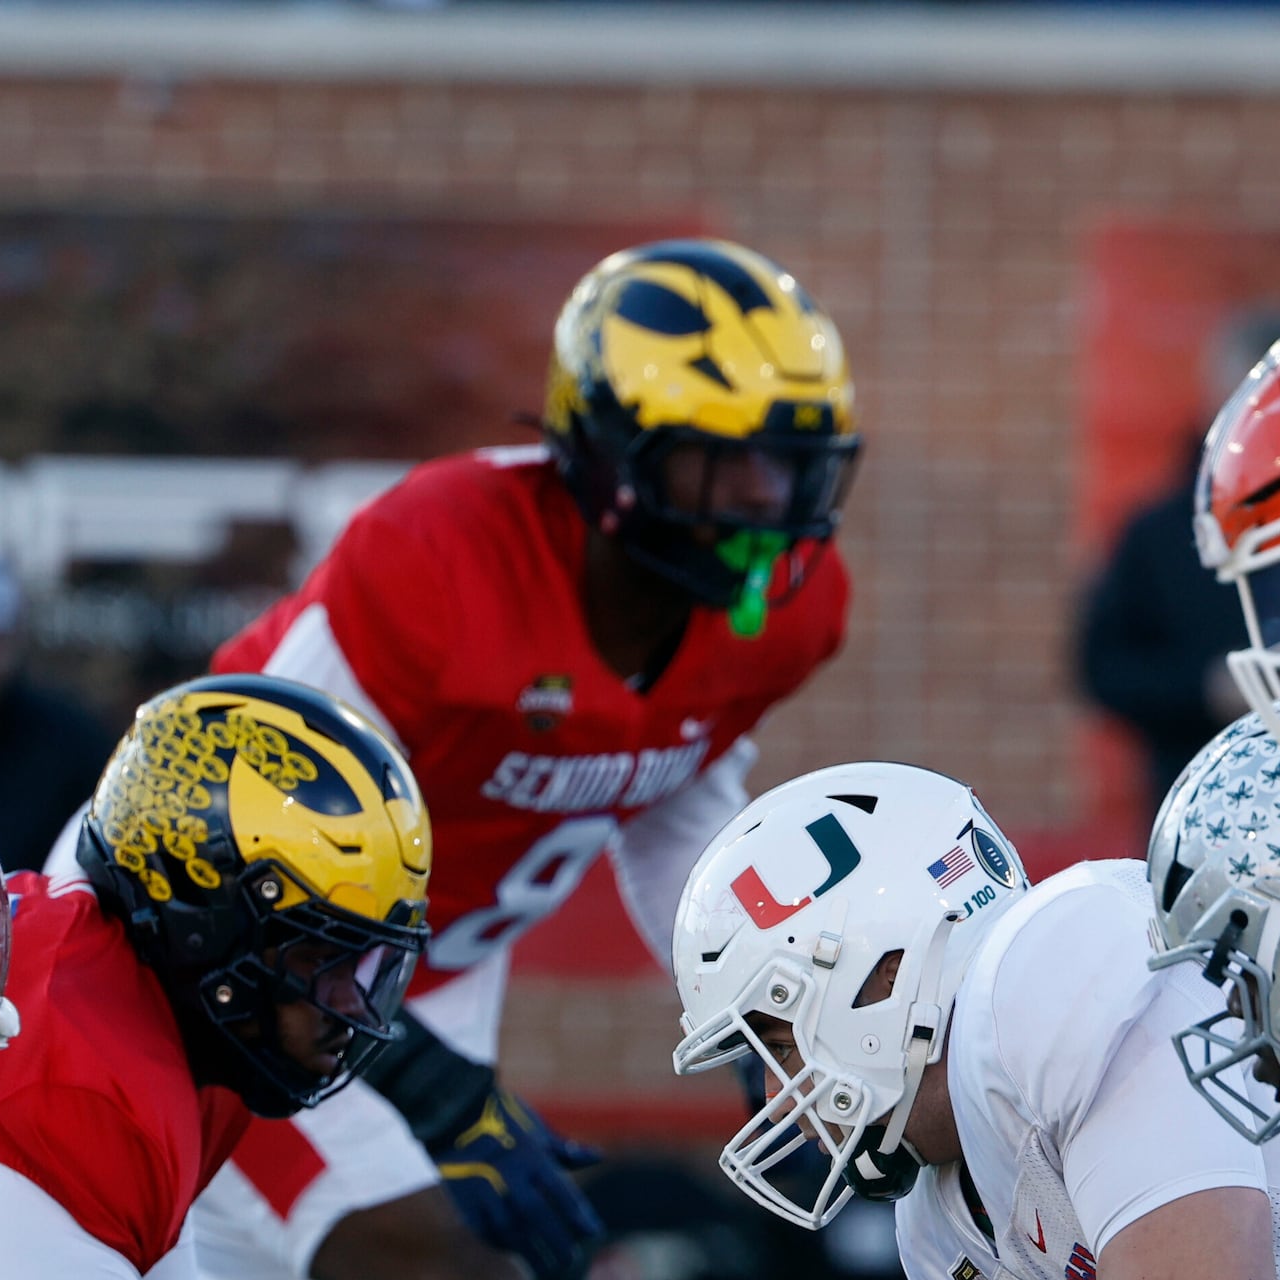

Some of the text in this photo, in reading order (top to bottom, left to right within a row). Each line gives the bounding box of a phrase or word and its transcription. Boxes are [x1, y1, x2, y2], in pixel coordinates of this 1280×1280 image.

[426, 815, 619, 971] 8
[729, 812, 862, 931] U
[971, 884, 997, 909] 100
